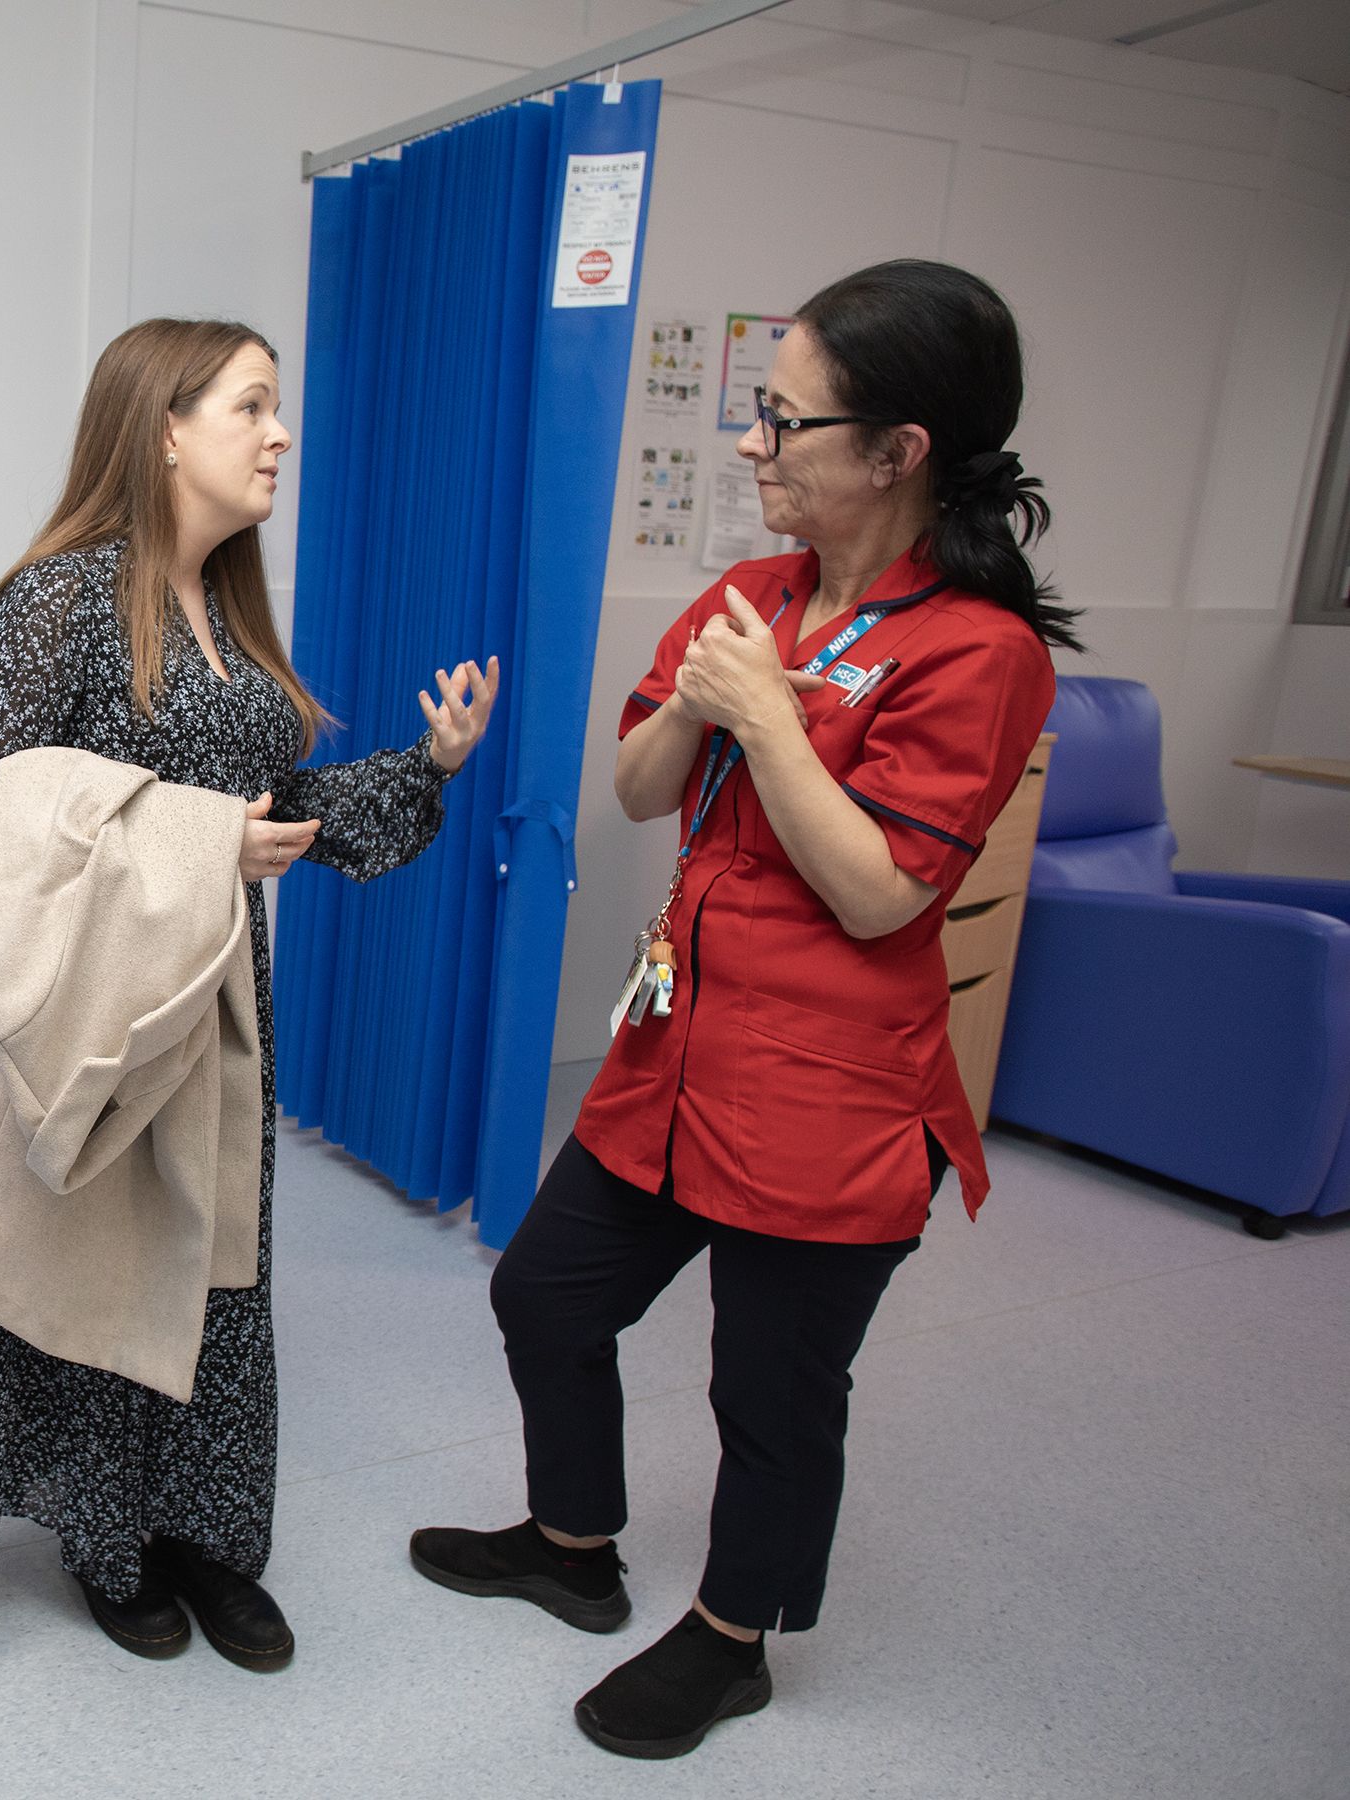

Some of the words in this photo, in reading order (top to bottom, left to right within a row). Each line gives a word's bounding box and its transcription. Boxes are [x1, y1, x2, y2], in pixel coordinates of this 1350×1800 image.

[828, 627, 857, 655] NHS
[803, 658, 823, 675] HS
[834, 667, 856, 682] HSC
